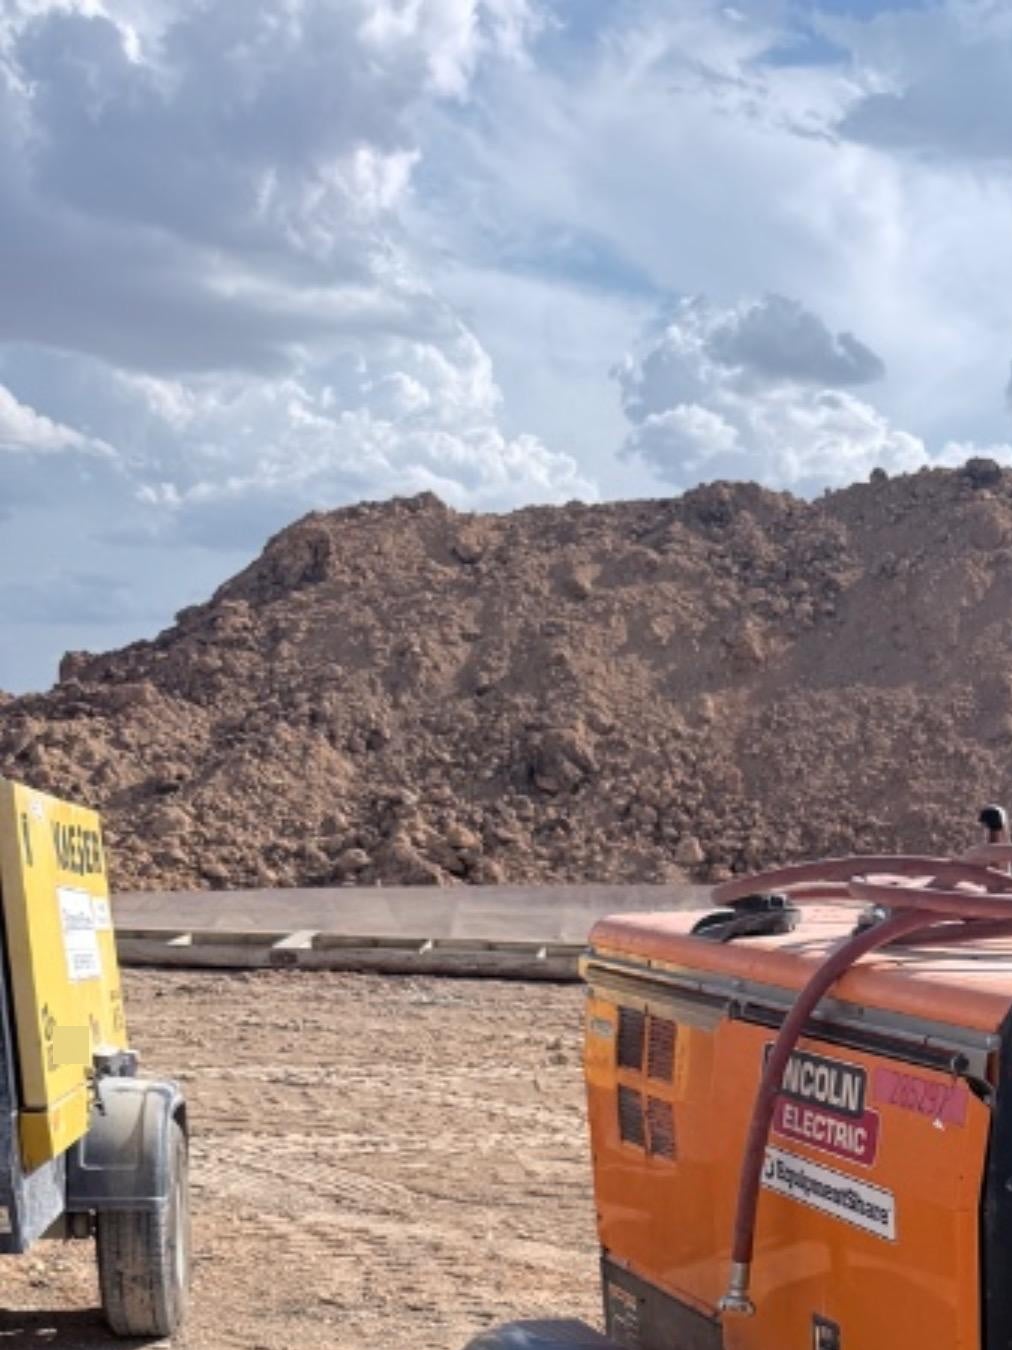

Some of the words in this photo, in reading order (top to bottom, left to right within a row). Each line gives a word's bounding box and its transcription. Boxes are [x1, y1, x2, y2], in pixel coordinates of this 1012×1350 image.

[782, 1056, 862, 1112] NCOLN
[781, 1103, 868, 1156] ELECTRIC
[776, 1158, 889, 1225] EquipmentShare
